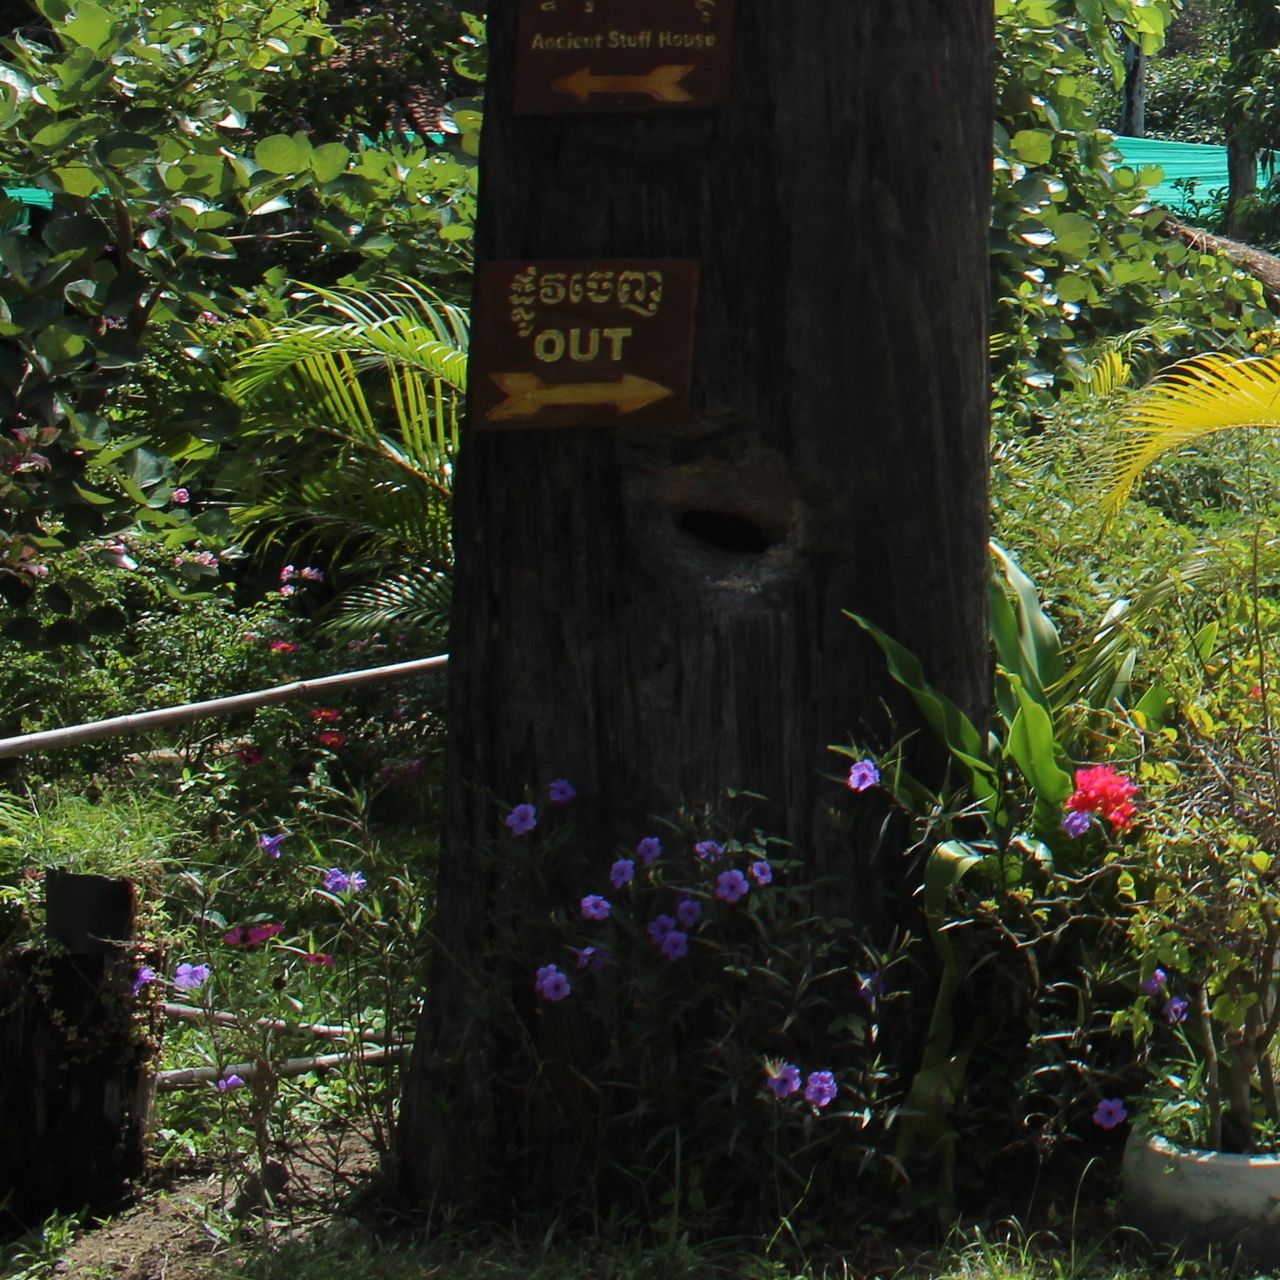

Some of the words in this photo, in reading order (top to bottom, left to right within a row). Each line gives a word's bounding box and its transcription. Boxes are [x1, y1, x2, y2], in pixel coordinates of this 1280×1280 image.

[531, 32, 602, 50] Ancient
[607, 30, 652, 49] Stuff
[659, 31, 716, 50] House
[509, 266, 663, 338] ផ្លូវចេញ
[534, 327, 632, 362] OUT
